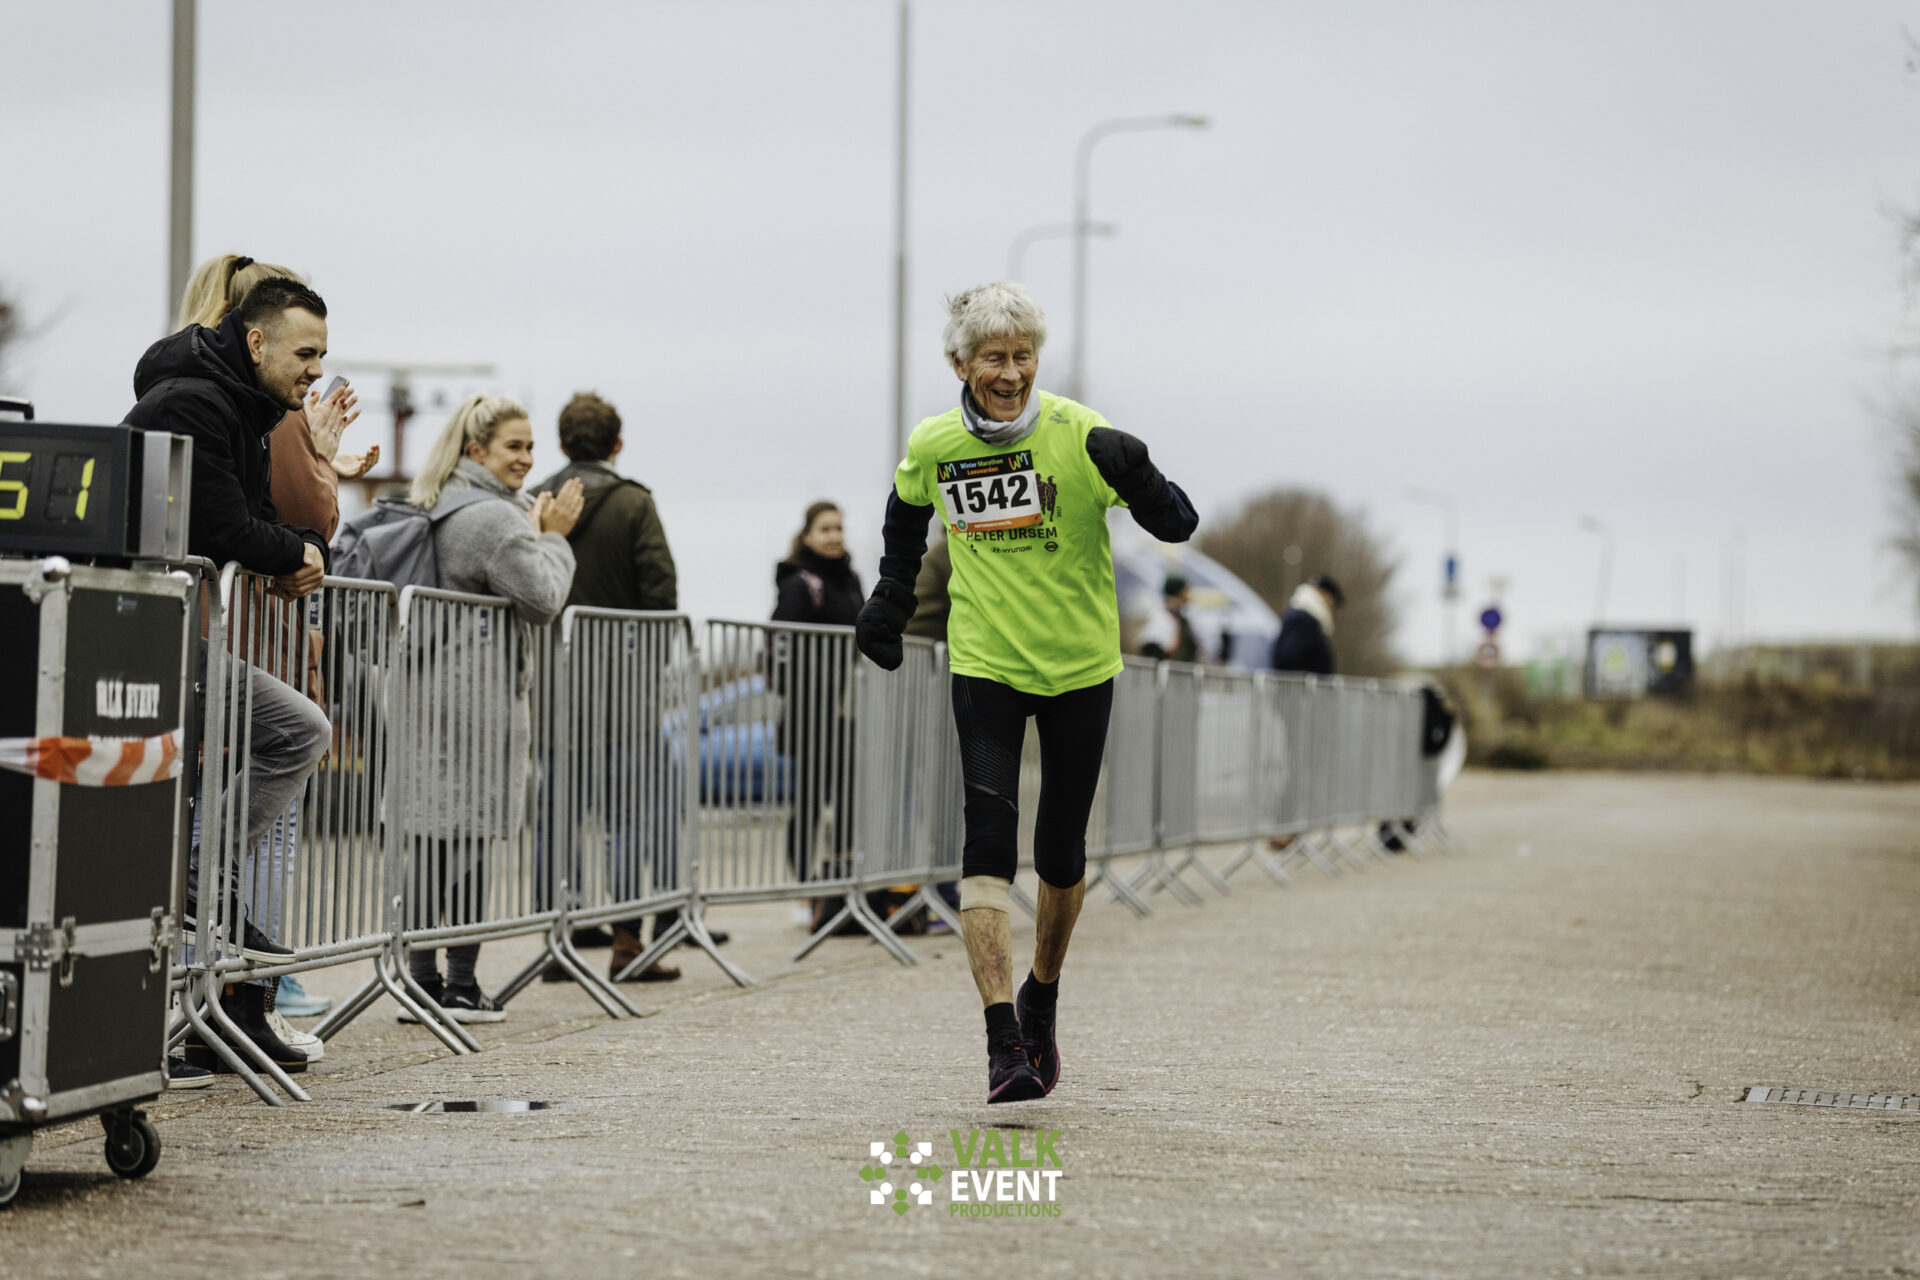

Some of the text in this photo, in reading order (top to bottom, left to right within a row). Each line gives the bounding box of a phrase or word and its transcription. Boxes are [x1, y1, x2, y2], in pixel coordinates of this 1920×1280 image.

[978, 458, 1004, 467] Marathon
[947, 475, 1031, 514] 1542
[966, 526, 1058, 541] PETER URSEM
[1002, 545, 1033, 554] HYUNDAI
